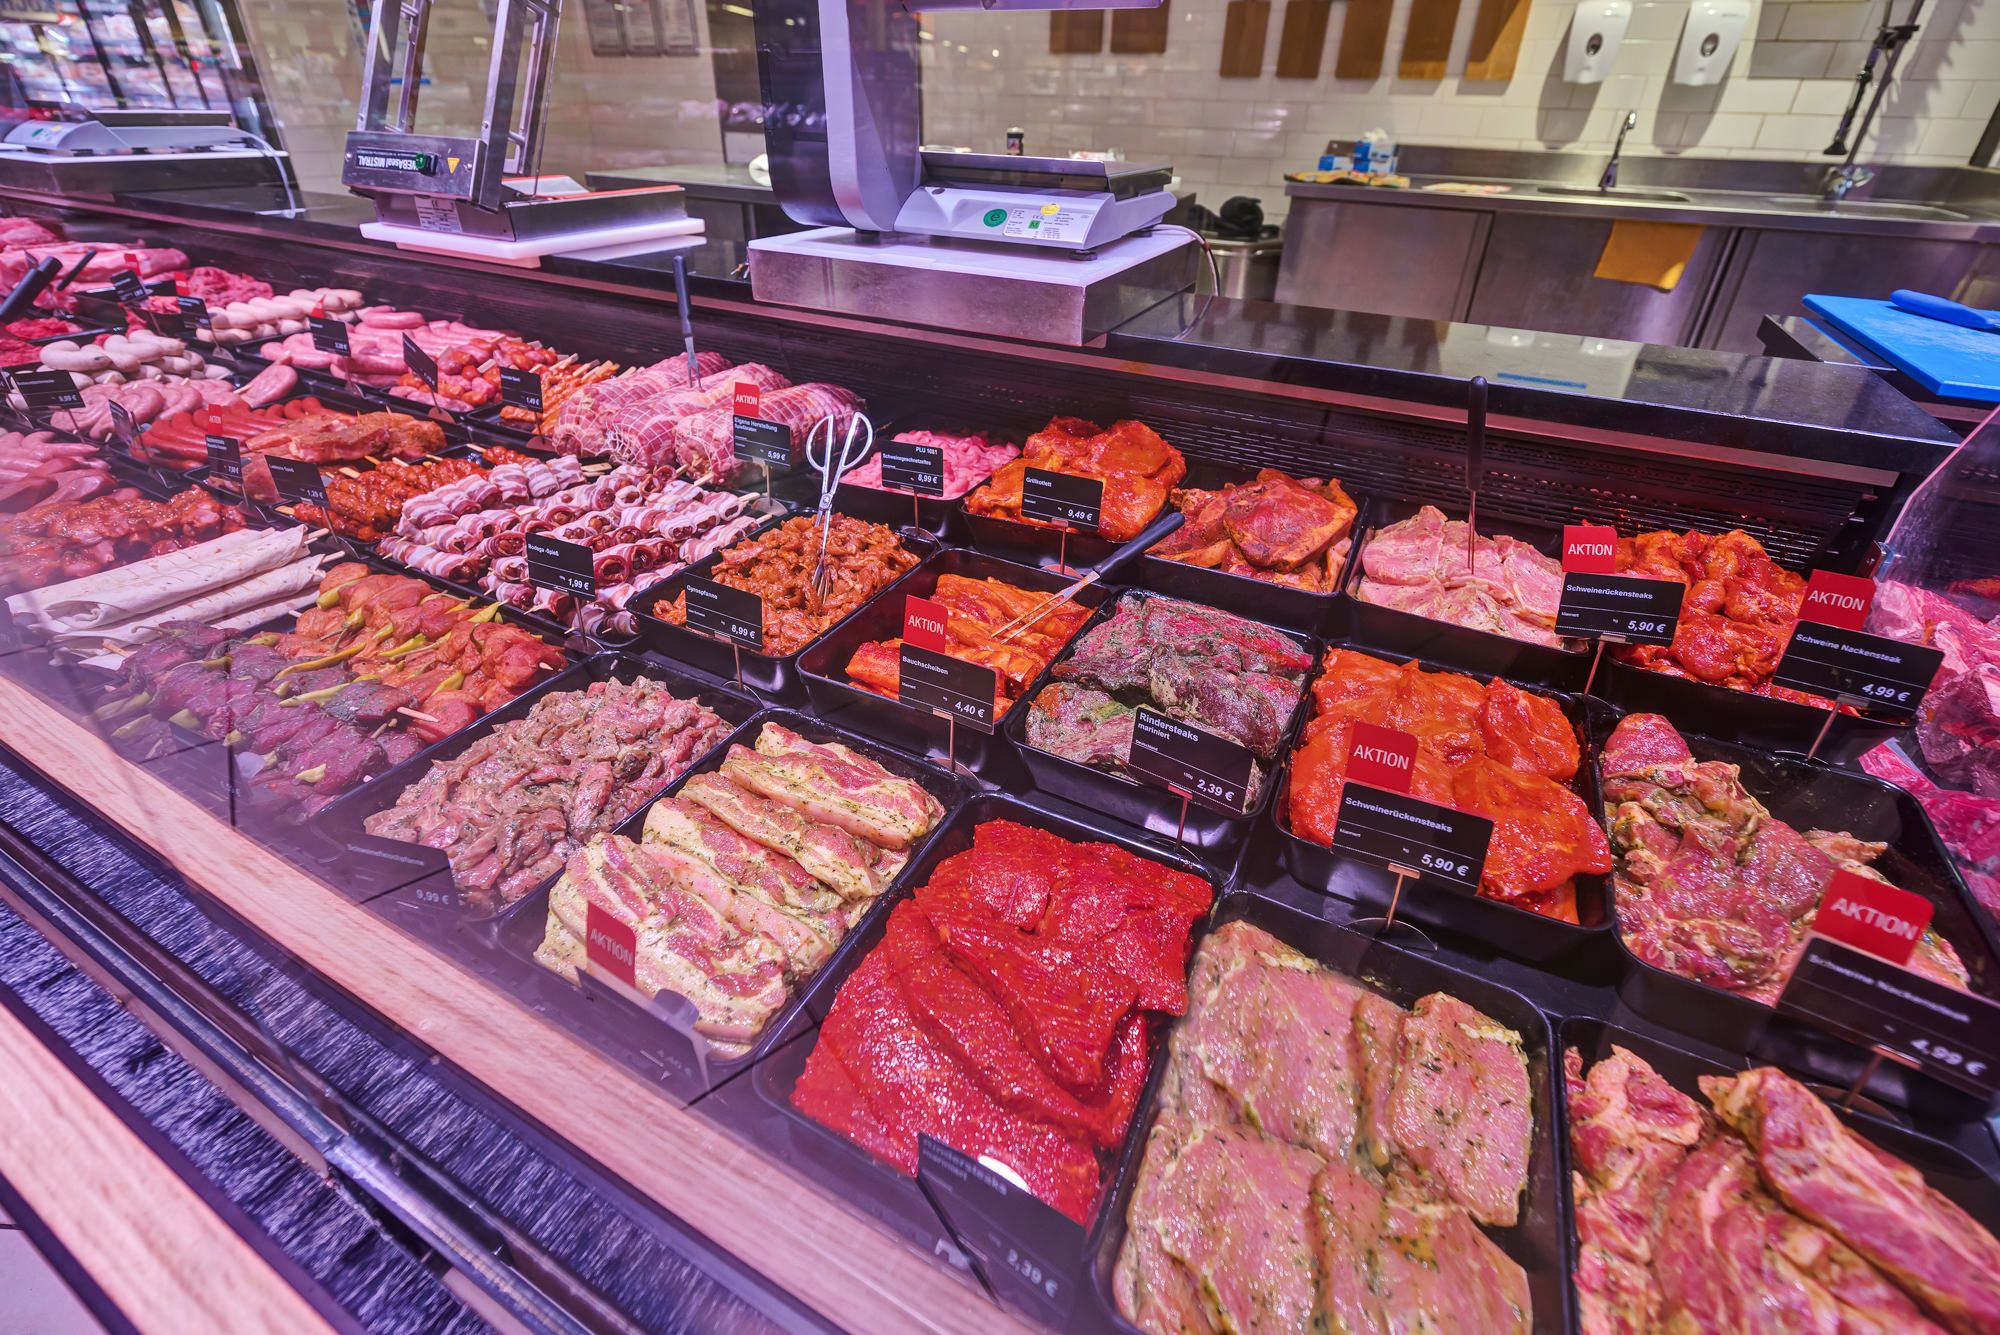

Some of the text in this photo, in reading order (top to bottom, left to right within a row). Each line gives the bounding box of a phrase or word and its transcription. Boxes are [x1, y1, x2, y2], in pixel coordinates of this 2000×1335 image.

[358, 155, 386, 168] MISTRAL
[735, 393, 758, 406] AKTION
[750, 420, 778, 433] Herstellung
[767, 450, 786, 461] 5,99 €
[917, 474, 938, 484] 8,99 €
[1067, 508, 1093, 521] 9,49 €
[1567, 543, 1613, 556] AKTION
[568, 578, 582, 589] 1,99
[583, 582, 590, 591] €
[686, 584, 718, 600] Gyrospfanne
[1566, 584, 1653, 600] Schweinerückensteaks
[1808, 590, 1865, 612] AKTION
[731, 624, 756, 639] 8,99 €
[908, 614, 945, 636] AKTION
[1627, 620, 1666, 633] 5,90 €
[1795, 633, 1902, 664] Schweine Nackensteak
[902, 655, 949, 676] Bauchscheiben
[1861, 683, 1911, 702] 4,99 €
[954, 701, 985, 719] 4,40 €
[1137, 722, 1171, 741] mariniert
[1139, 712, 1199, 743] Rindersteaks
[1353, 744, 1410, 771] AKTION
[1196, 778, 1223, 797] 2,39
[1224, 791, 1235, 802] €
[1344, 796, 1453, 834] Schweinerückensteaks
[1420, 852, 1469, 877] 5,90 €
[415, 889, 450, 905] 9,99 €
[1831, 897, 1919, 941] AKTION
[589, 926, 634, 967] AKTION
[1808, 953, 1874, 986] Schweine
[1910, 1038, 1987, 1077] 4,99 €
[923, 1138, 1008, 1196] Rindersteaks
[1006, 1248, 1059, 1298] 2,39 €
